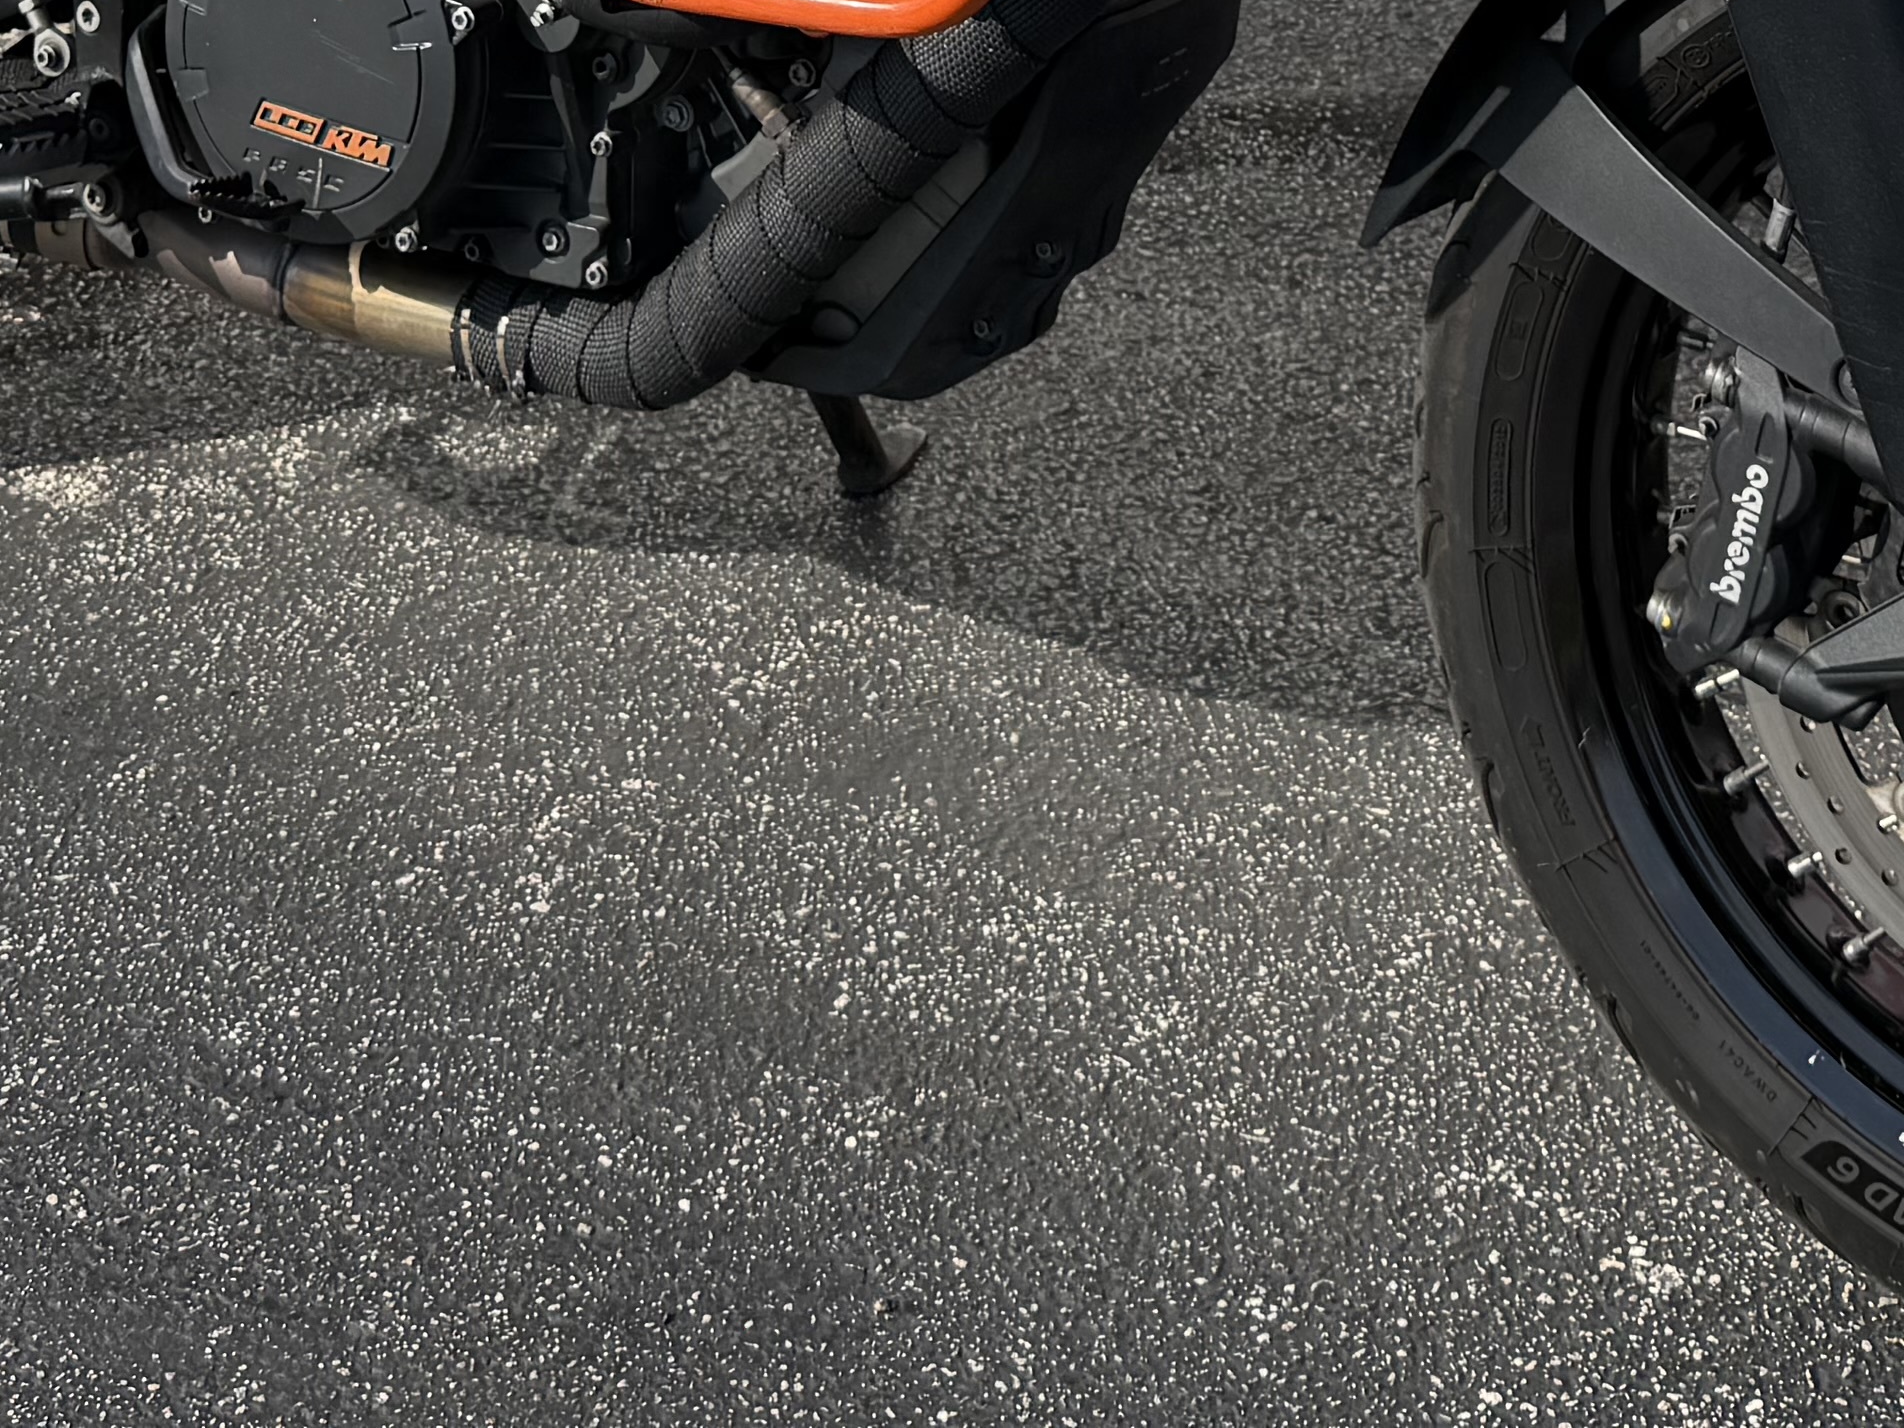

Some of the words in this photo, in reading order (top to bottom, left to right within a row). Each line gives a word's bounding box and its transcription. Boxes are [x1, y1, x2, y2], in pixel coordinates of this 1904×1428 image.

[322, 125, 393, 166] KTM
[1708, 462, 1771, 607] brembo
[1826, 1155, 1860, 1183] 6
